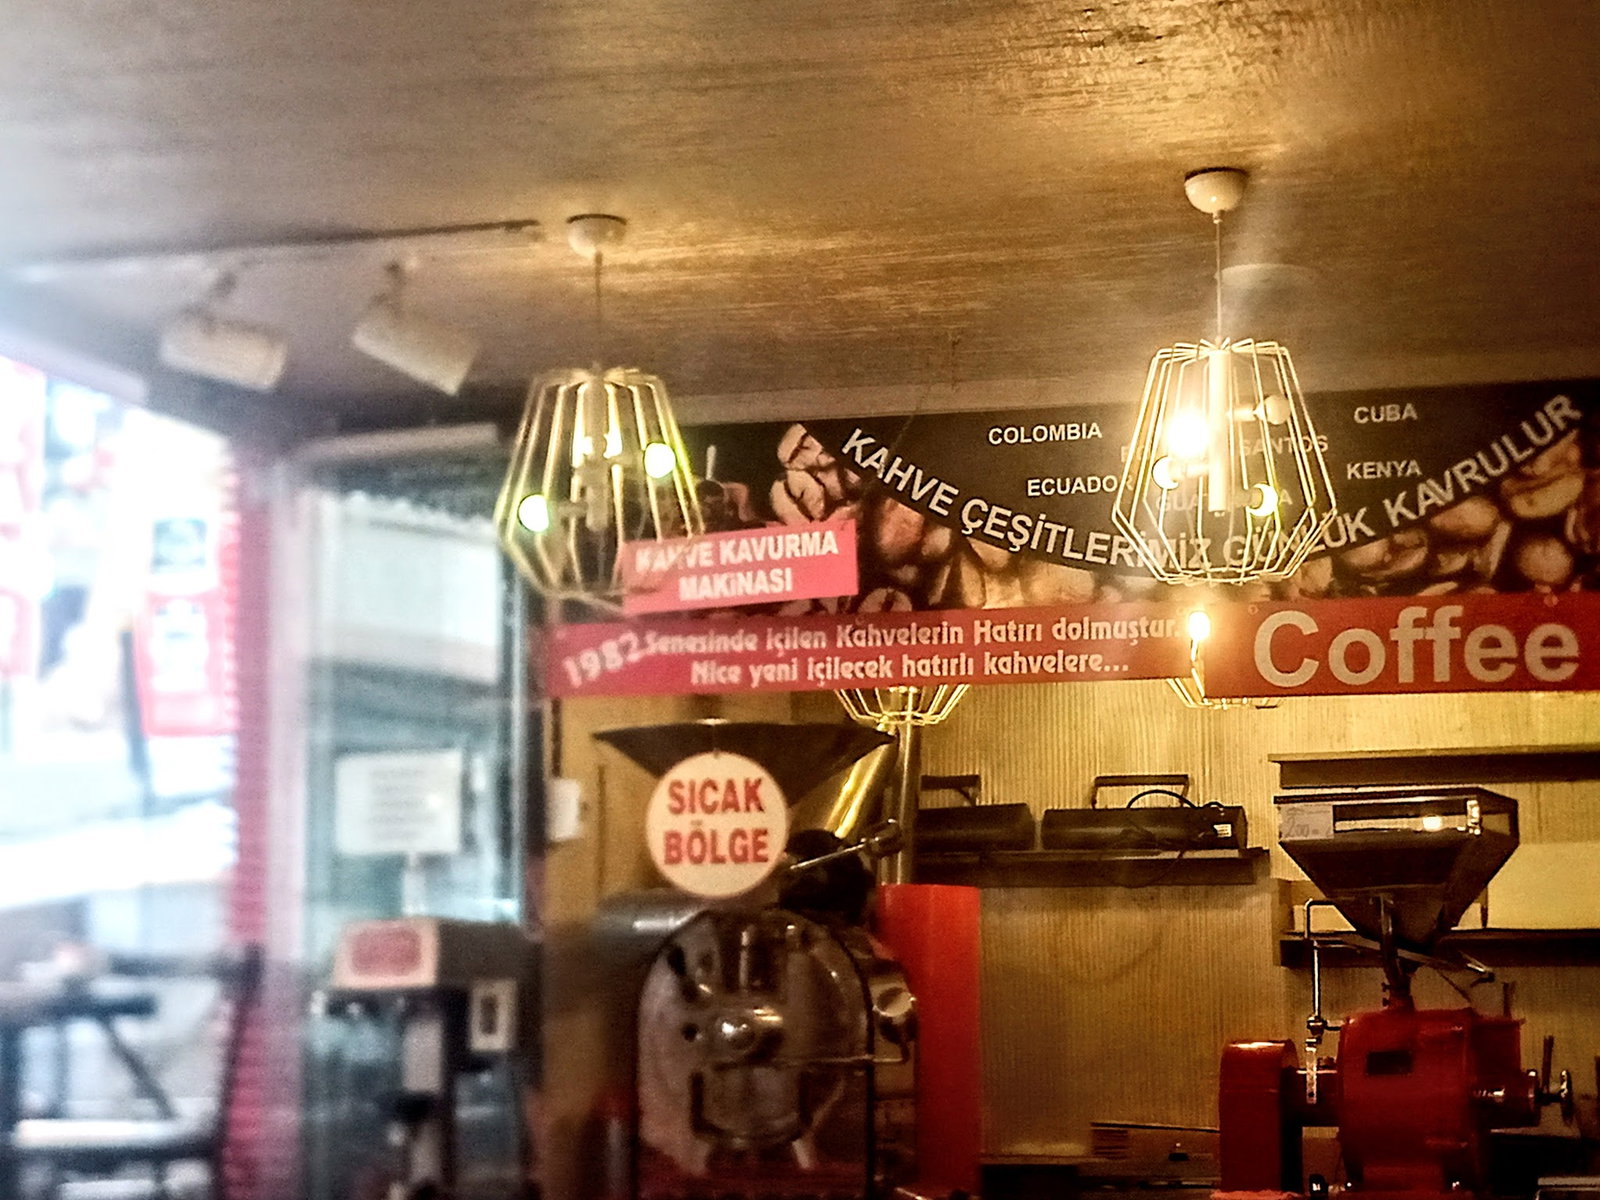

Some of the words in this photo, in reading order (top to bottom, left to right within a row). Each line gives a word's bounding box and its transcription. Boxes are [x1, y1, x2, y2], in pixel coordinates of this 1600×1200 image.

[1354, 404, 1418, 425] CUBA
[988, 421, 1103, 446] COLOMBIA
[841, 427, 960, 517] KAHVE
[1382, 394, 1583, 528] KAVRULUR
[1347, 458, 1422, 481] KENYA
[718, 529, 840, 566] KAVURMA
[836, 621, 964, 649] Kahvelerin
[974, 619, 1042, 646] Hatırı
[1254, 604, 1580, 688] Coffee
[749, 657, 798, 688] yeni
[902, 652, 974, 677] hatırlı
[984, 649, 1129, 675] kahvelere...
[667, 777, 765, 815] SICAK
[663, 819, 769, 865] BÖLGE
